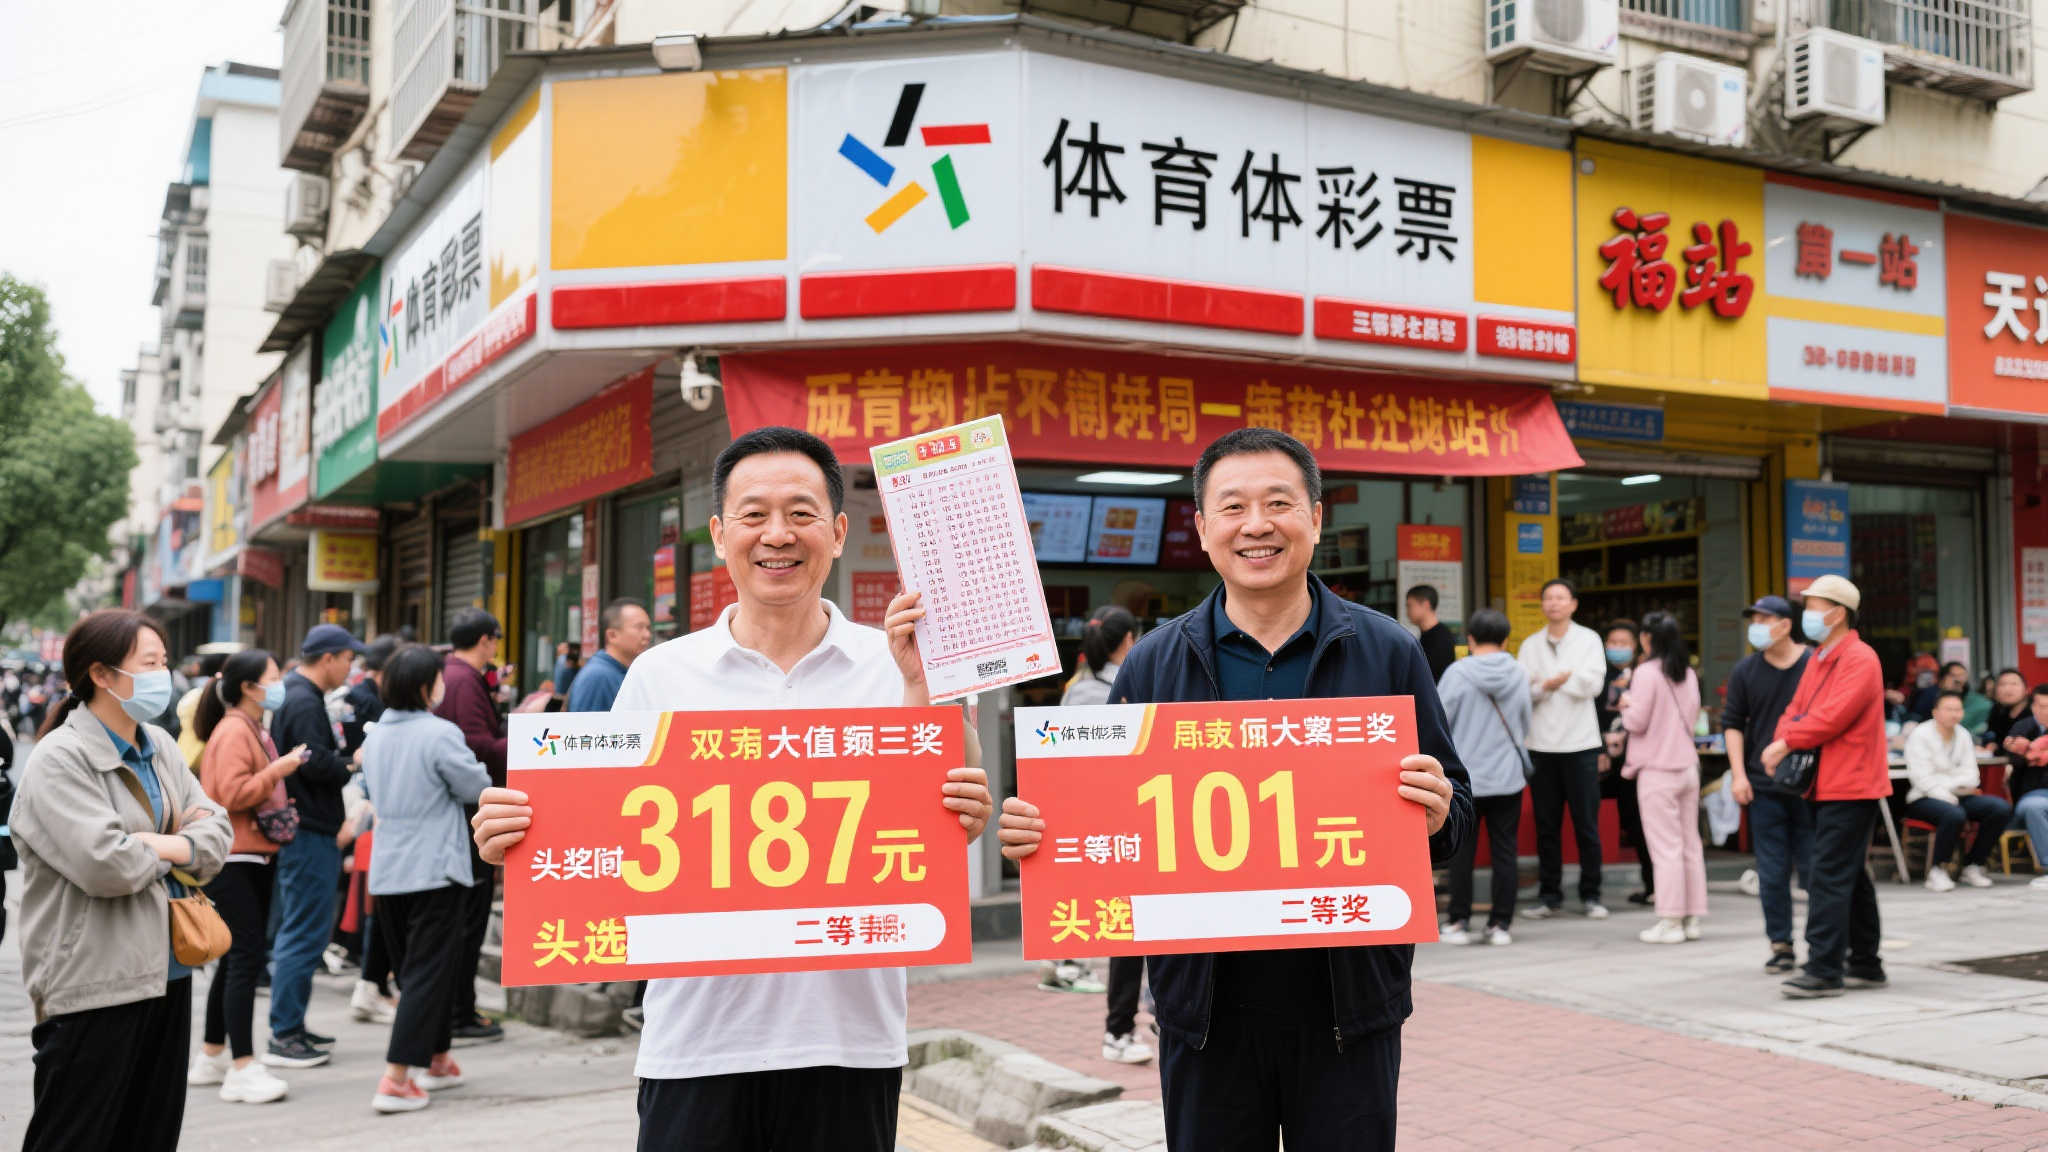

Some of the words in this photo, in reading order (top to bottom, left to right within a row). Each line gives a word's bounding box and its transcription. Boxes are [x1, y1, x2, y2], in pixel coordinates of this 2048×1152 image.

[1042, 117, 1459, 263] 体育体彩票
[1598, 206, 1756, 319] 福站
[1280, 894, 1371, 925] 二等奖
